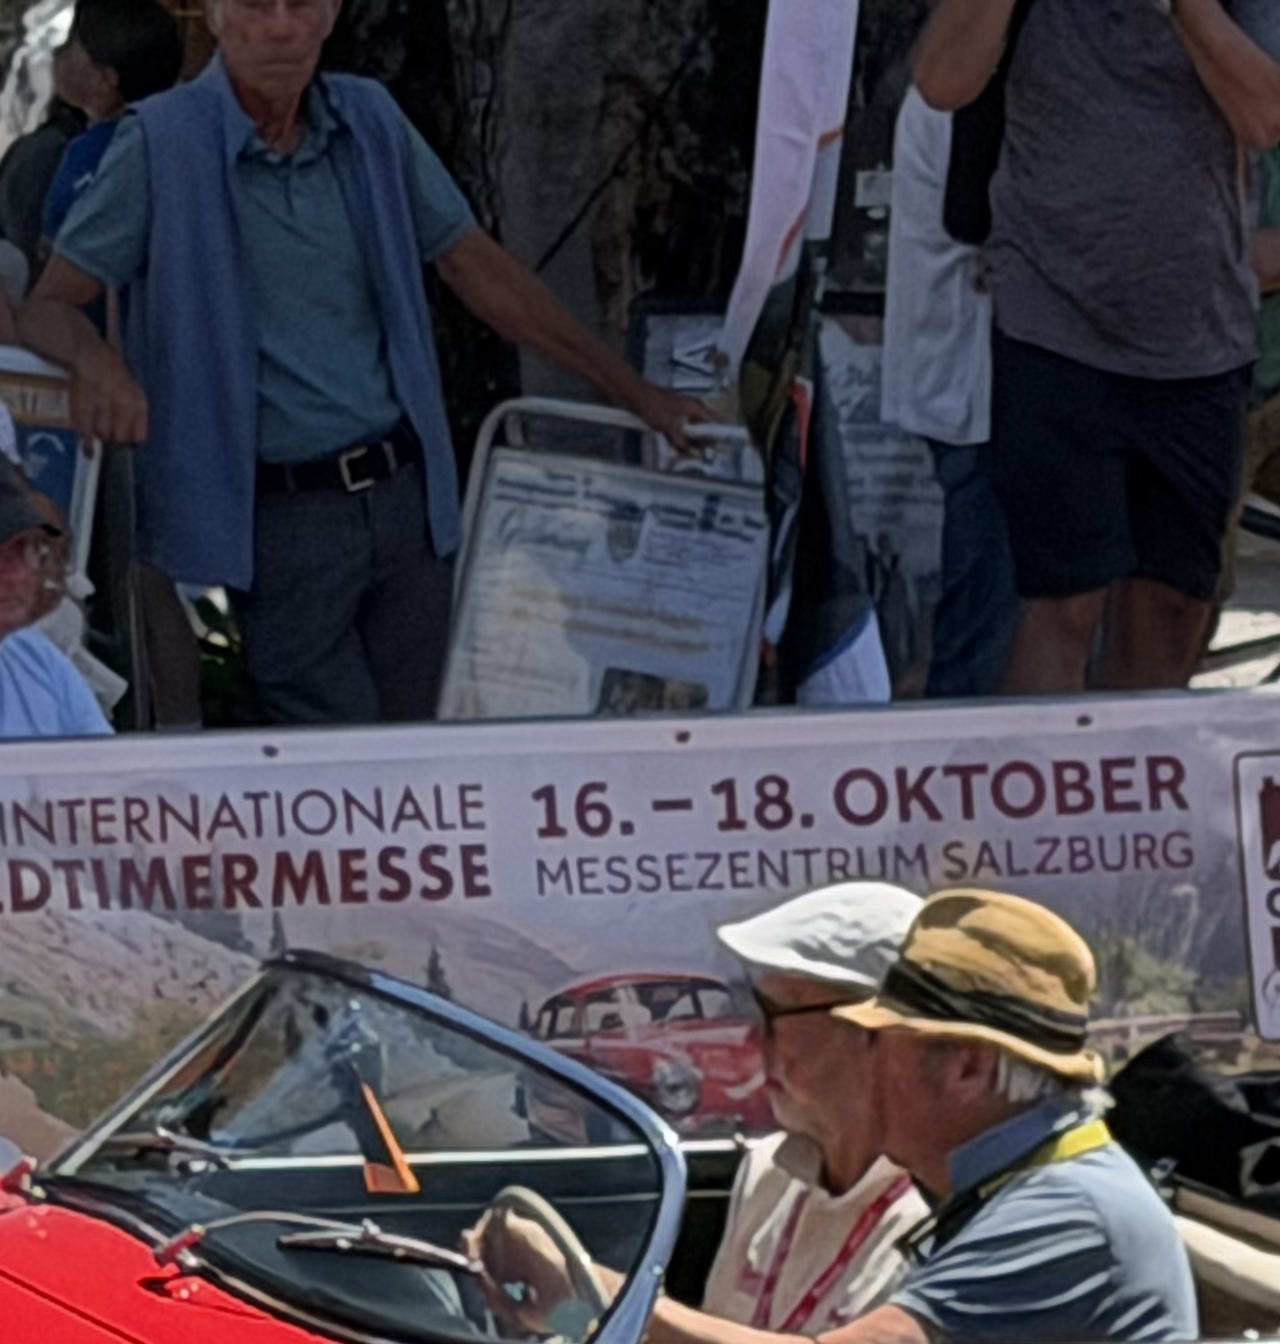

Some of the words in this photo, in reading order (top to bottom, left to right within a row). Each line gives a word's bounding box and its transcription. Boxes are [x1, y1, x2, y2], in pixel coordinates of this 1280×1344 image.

[531, 781, 634, 838] 16.
[710, 775, 814, 832] 18.
[832, 754, 1190, 827] OKTOBER
[535, 842, 930, 896] MESSEZENTRUM
[943, 830, 1195, 876] SALZBURG
